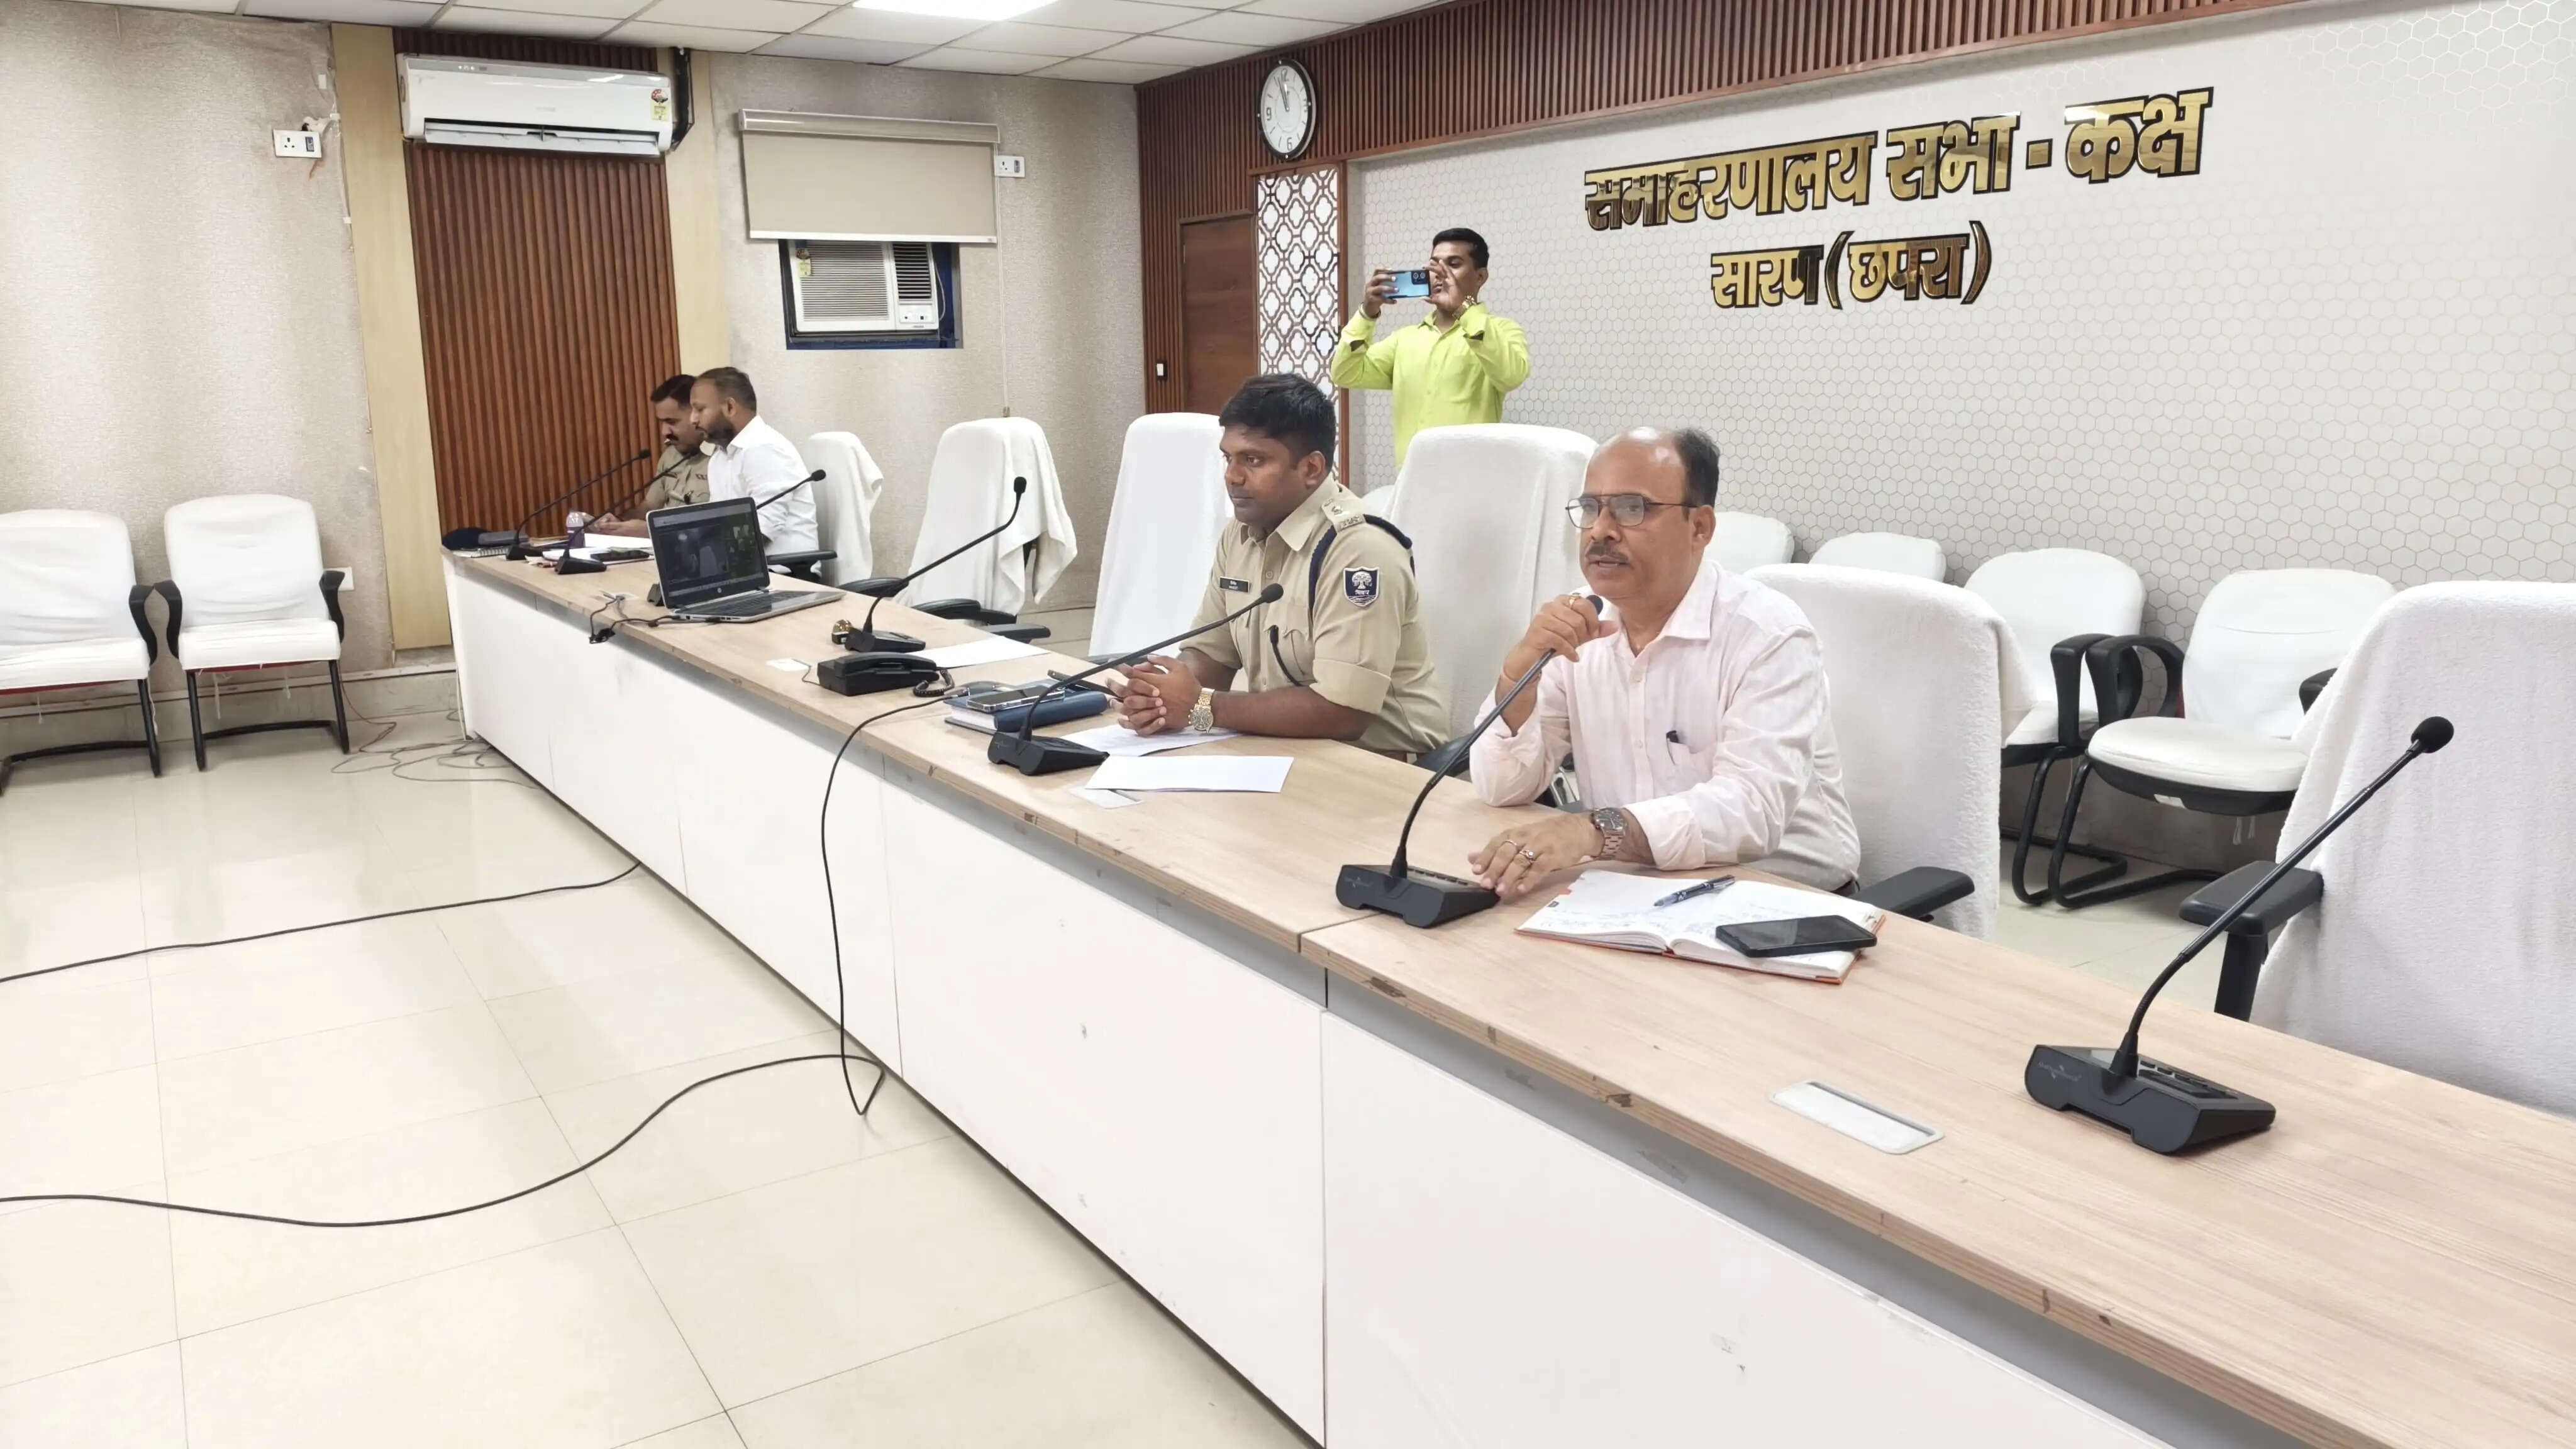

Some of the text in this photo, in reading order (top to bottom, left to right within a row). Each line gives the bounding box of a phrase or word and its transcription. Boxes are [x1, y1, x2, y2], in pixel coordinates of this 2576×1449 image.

[1266, 107, 1272, 121] 9
[1287, 137, 1293, 152] 6
[1584, 131, 1879, 231] समाहरणालय
[1886, 111, 2021, 201] सभा
[2064, 86, 2214, 184] कक्ष
[1711, 220, 1992, 310] सारण (छपरा)
